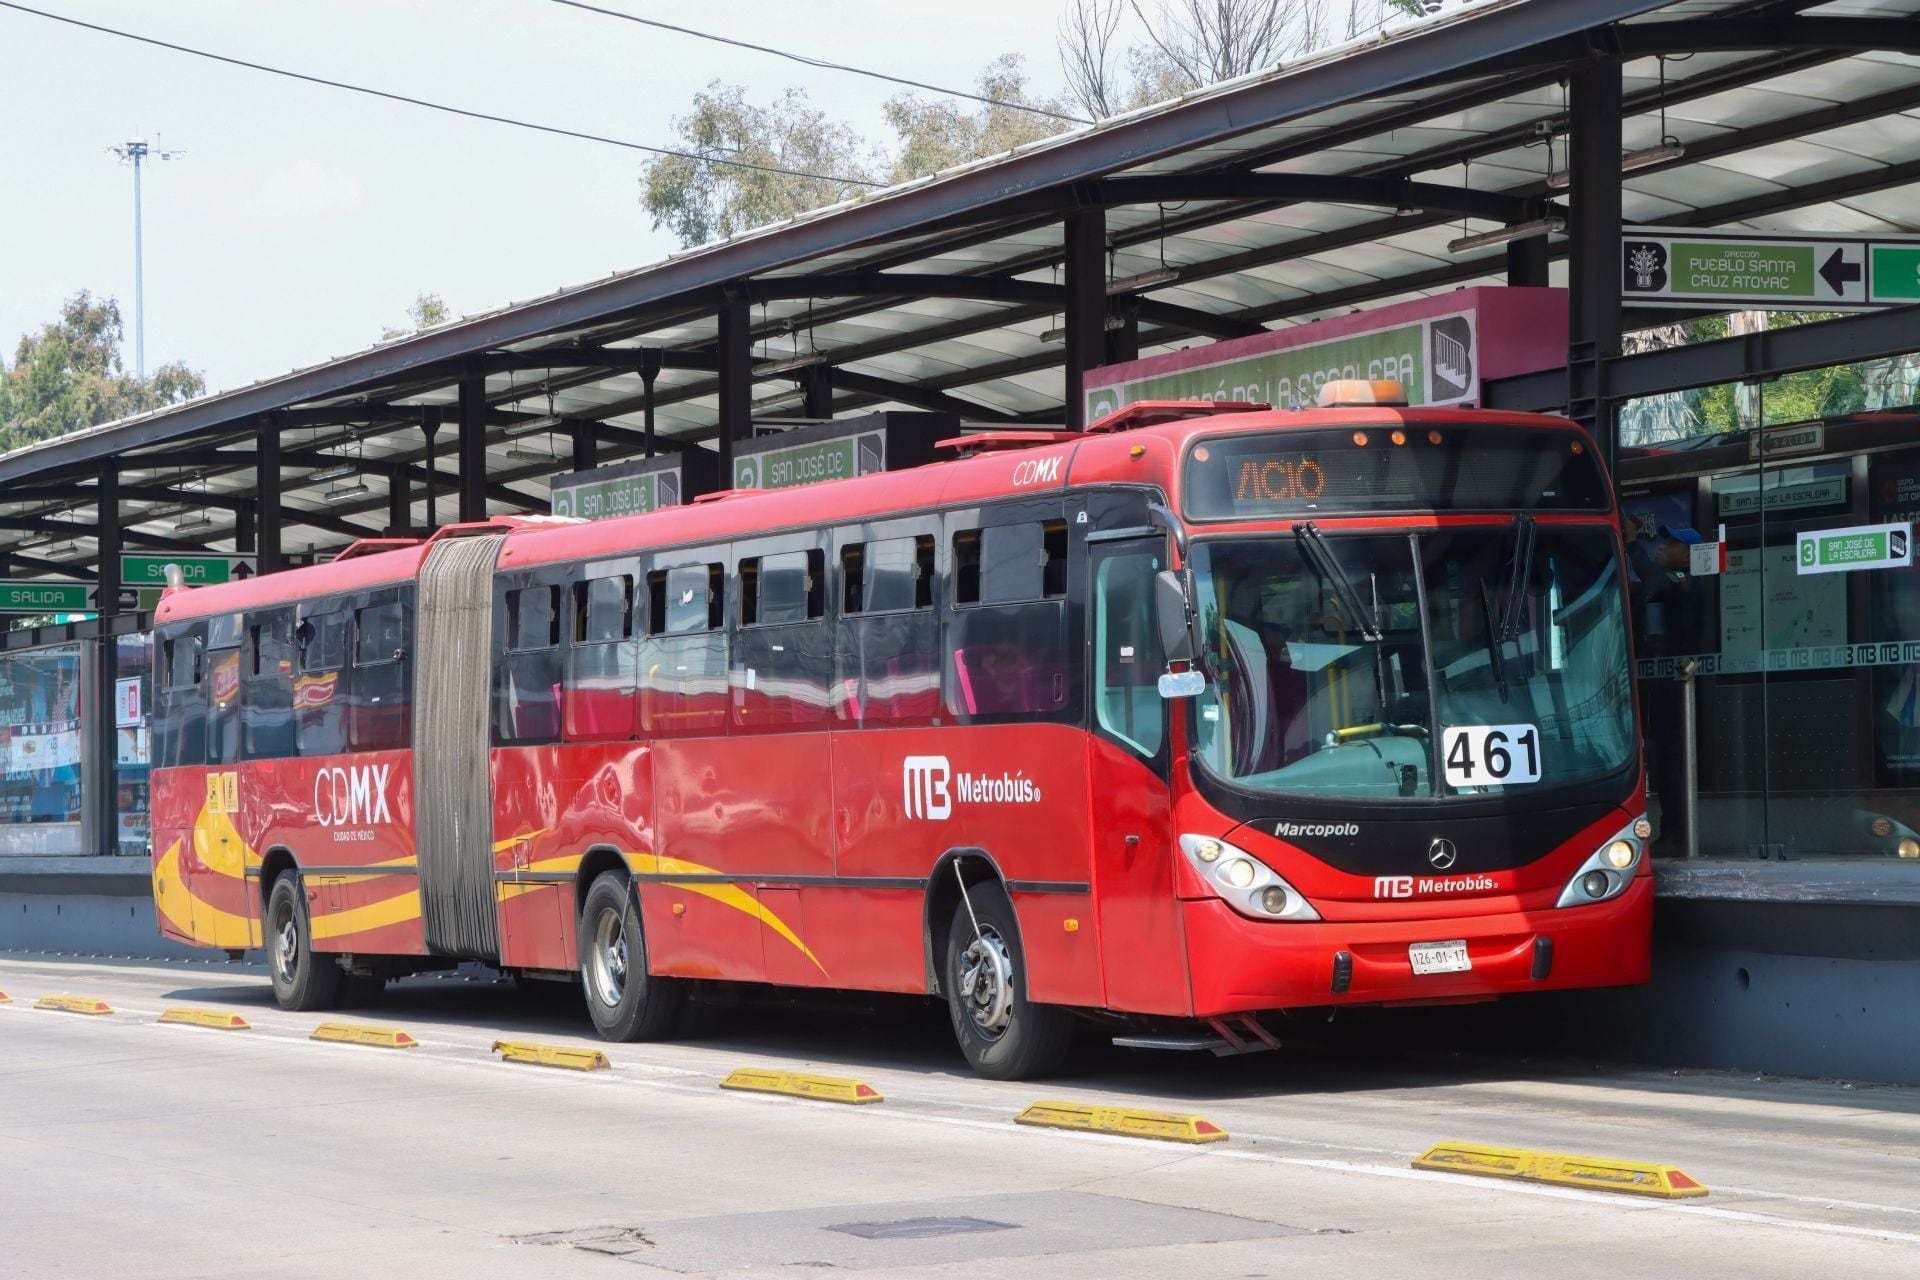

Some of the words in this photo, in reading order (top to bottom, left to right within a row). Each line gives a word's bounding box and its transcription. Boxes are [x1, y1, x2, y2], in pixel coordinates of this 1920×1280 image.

[1689, 258, 1745, 272] PUEBLO
[1749, 260, 1795, 273] SANTA
[1691, 275, 1728, 288] CRUZ
[1732, 276, 1789, 290] ATOYAC
[1774, 431, 1814, 447] SALIDA
[771, 461, 793, 483] SAN
[795, 448, 824, 480] JOSÉ
[827, 452, 843, 473] DE
[1013, 456, 1063, 486] CDMX
[584, 494, 603, 515] SAN
[606, 483, 631, 511] JOSÉ
[633, 486, 647, 507] DE
[1828, 541, 1843, 551] SAN
[1844, 537, 1863, 550] JOSÉ
[1864, 538, 1875, 548] DE
[1803, 543, 1813, 562] 3
[1829, 551, 1839, 560] LA
[1840, 548, 1877, 560] ESCALERA
[147, 564, 205, 577] SADA
[11, 591, 64, 603] SALIDA
[1447, 729, 1537, 778] 461
[314, 764, 391, 826] CDMX
[333, 831, 350, 841] CIUDAD
[357, 828, 375, 841] MÉXICO
[1274, 822, 1359, 837] Marcopolo
[1414, 950, 1465, 965] 126-01-17
